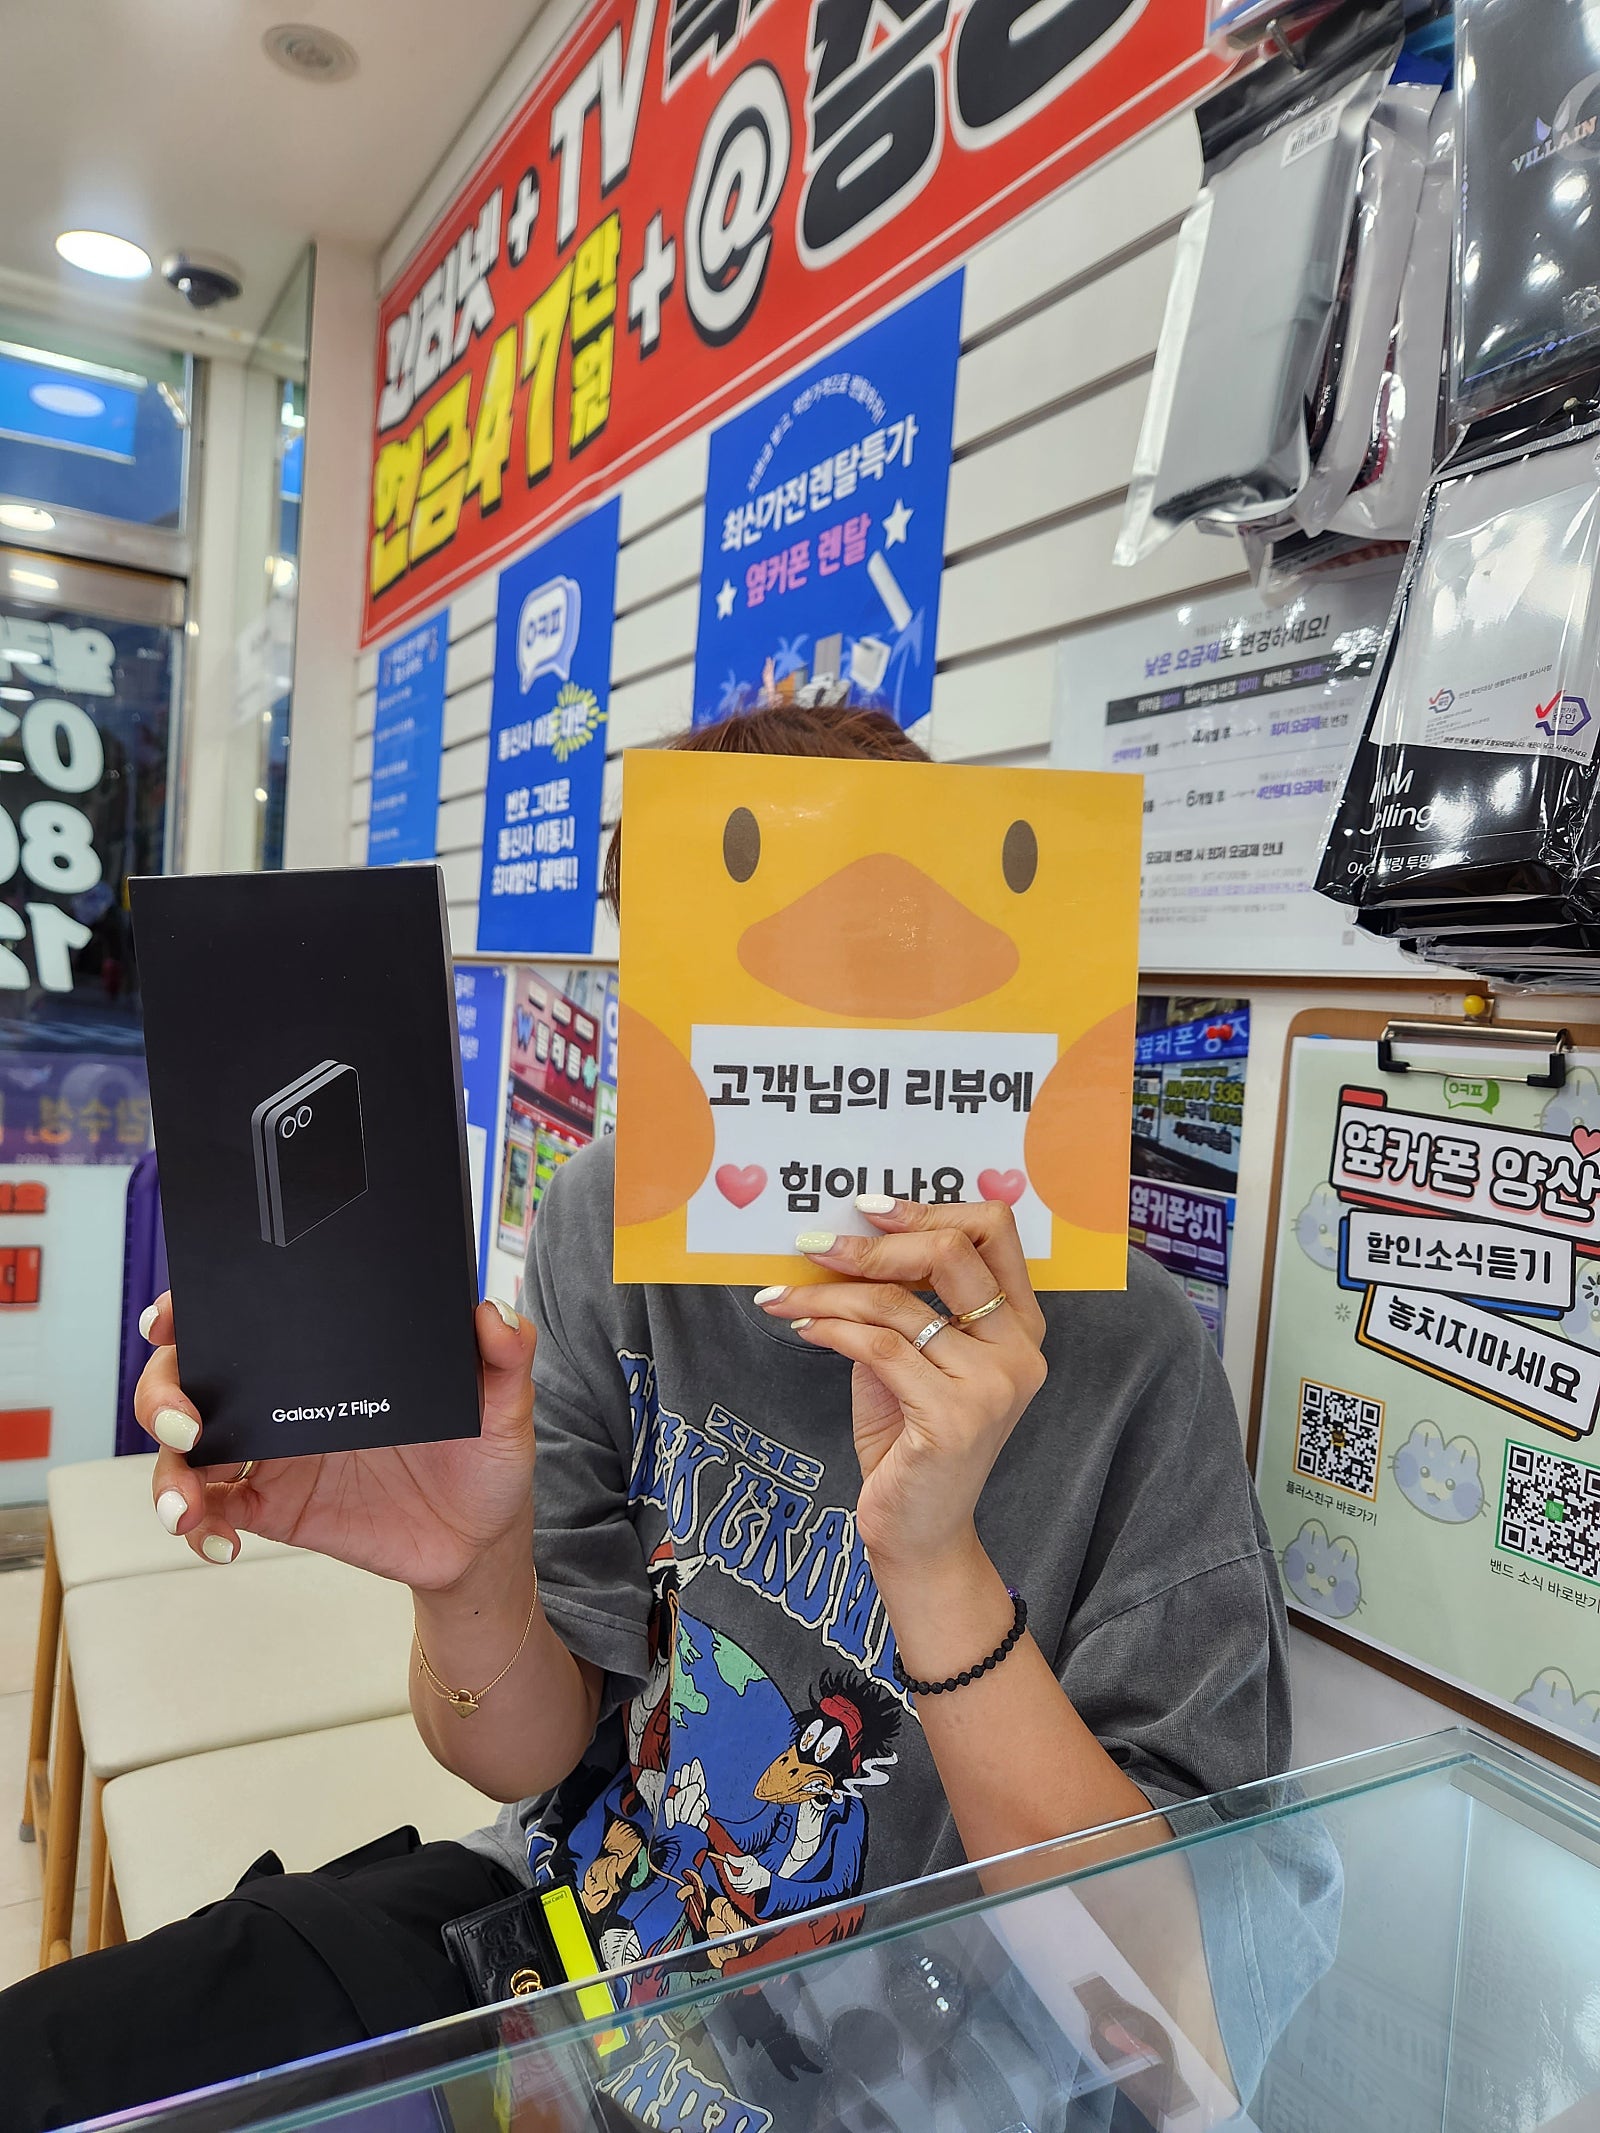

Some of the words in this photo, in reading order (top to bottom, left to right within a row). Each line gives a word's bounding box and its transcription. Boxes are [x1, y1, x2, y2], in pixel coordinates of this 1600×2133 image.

[1511, 115, 1597, 172] VILLAIN
[745, 539, 811, 608] 옆커폰
[817, 512, 872, 577] 렌탈
[531, 777, 571, 818] 그대로
[535, 815, 576, 854] 이동시
[709, 1063, 890, 1115] 고객님의
[905, 1068, 1034, 1115] 리뷰에
[1342, 1120, 1481, 1199] 옆커폰
[779, 1160, 868, 1214] 힘이
[272, 1406, 336, 1423] Galaxy
[338, 1402, 348, 1417] Z
[351, 1398, 391, 1418] Flip6
[1286, 1480, 1334, 1509] 플러스친구
[1336, 1499, 1378, 1527] 바로가기
[1490, 1557, 1514, 1579] 밴드
[1517, 1570, 1544, 1592] 소식
